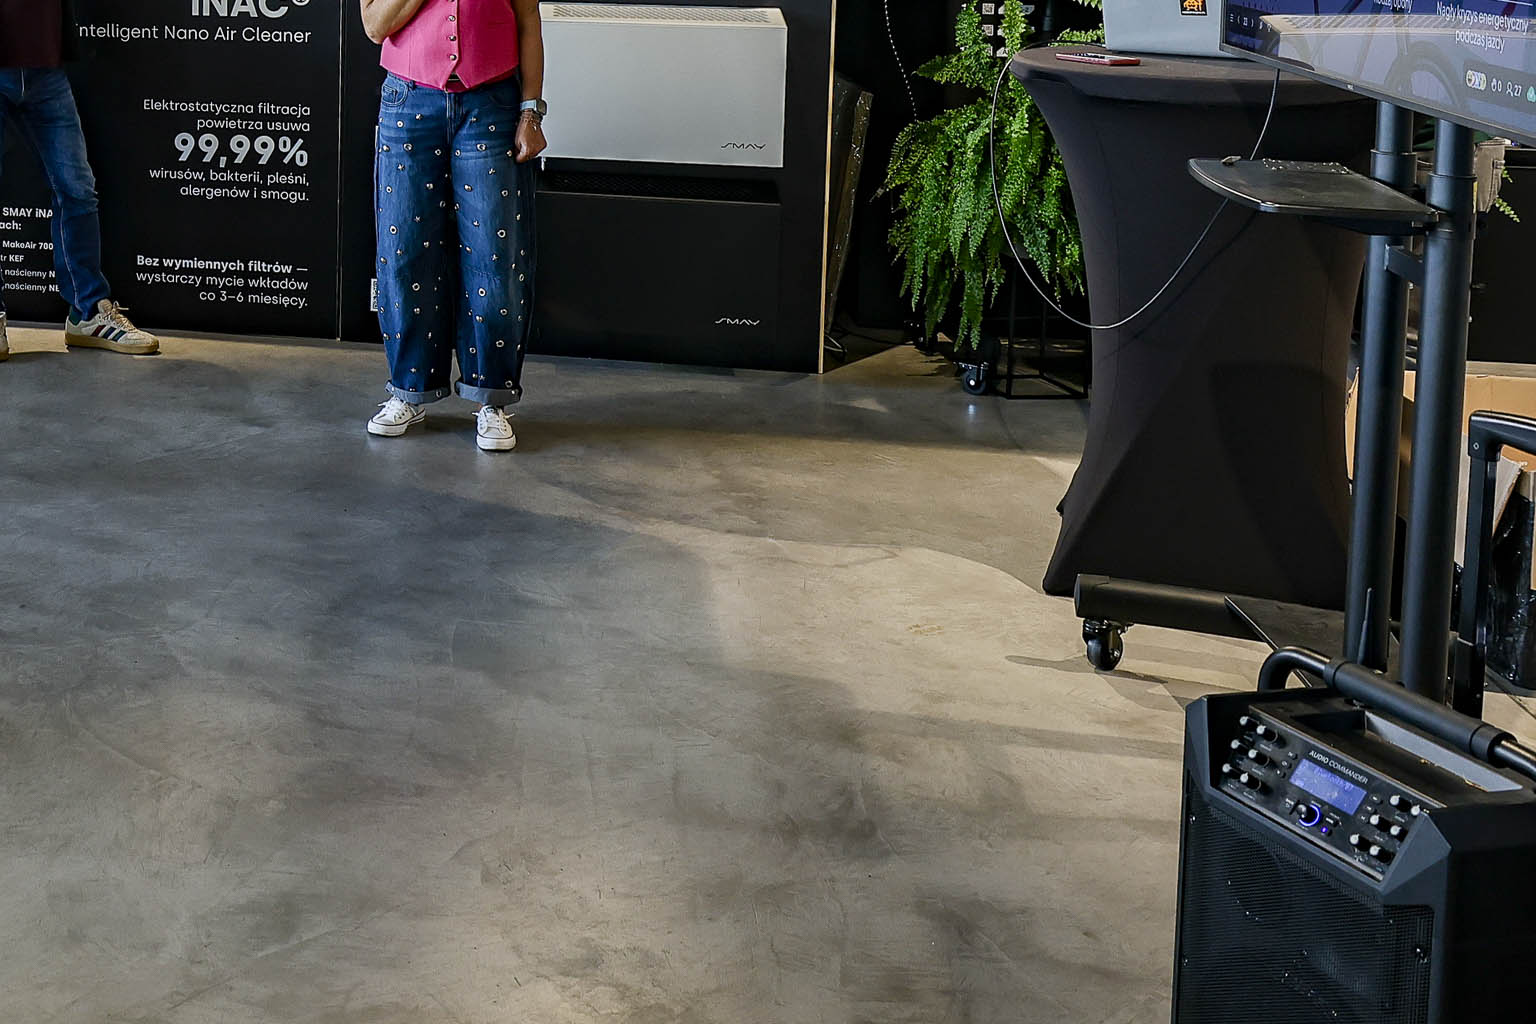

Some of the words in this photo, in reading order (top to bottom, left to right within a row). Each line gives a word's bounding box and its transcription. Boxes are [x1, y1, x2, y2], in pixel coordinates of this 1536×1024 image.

[76, 23, 159, 43] ntelligent
[164, 25, 209, 41] Nano
[214, 26, 237, 41] Air
[242, 26, 312, 43] Cleaner
[1479, 13, 1529, 35] energetyczny
[143, 98, 254, 115] Elektrostatyczna
[258, 102, 311, 118] filtracja
[197, 117, 263, 131] powietrza
[267, 122, 311, 132] usuwa
[174, 132, 308, 168] 99,99%
[149, 168, 206, 182] wirusów,
[209, 169, 263, 184] bakterii,
[267, 171, 310, 186] pleśni,
[180, 184, 250, 199] alergenów
[253, 187, 257, 199] i
[260, 189, 310, 204] smogu.
[2, 207, 33, 218] SMAY
[35, 208, 54, 219] iNA
[9, 254, 25, 263] KEF
[136, 255, 159, 267] Bez
[163, 257, 244, 273] wymiennych
[248, 260, 293, 274] filtrów
[4, 268, 47, 280] naścienny
[136, 271, 202, 287] wystarczy
[205, 275, 245, 289] mycie
[248, 276, 309, 291] wkładów
[4, 282, 47, 294] naścienny
[199, 291, 215, 302] co
[248, 292, 308, 309] miesięcy.
[1309, 750, 1329, 764] AUDIO
[1329, 760, 1369, 784] COMMANDER
